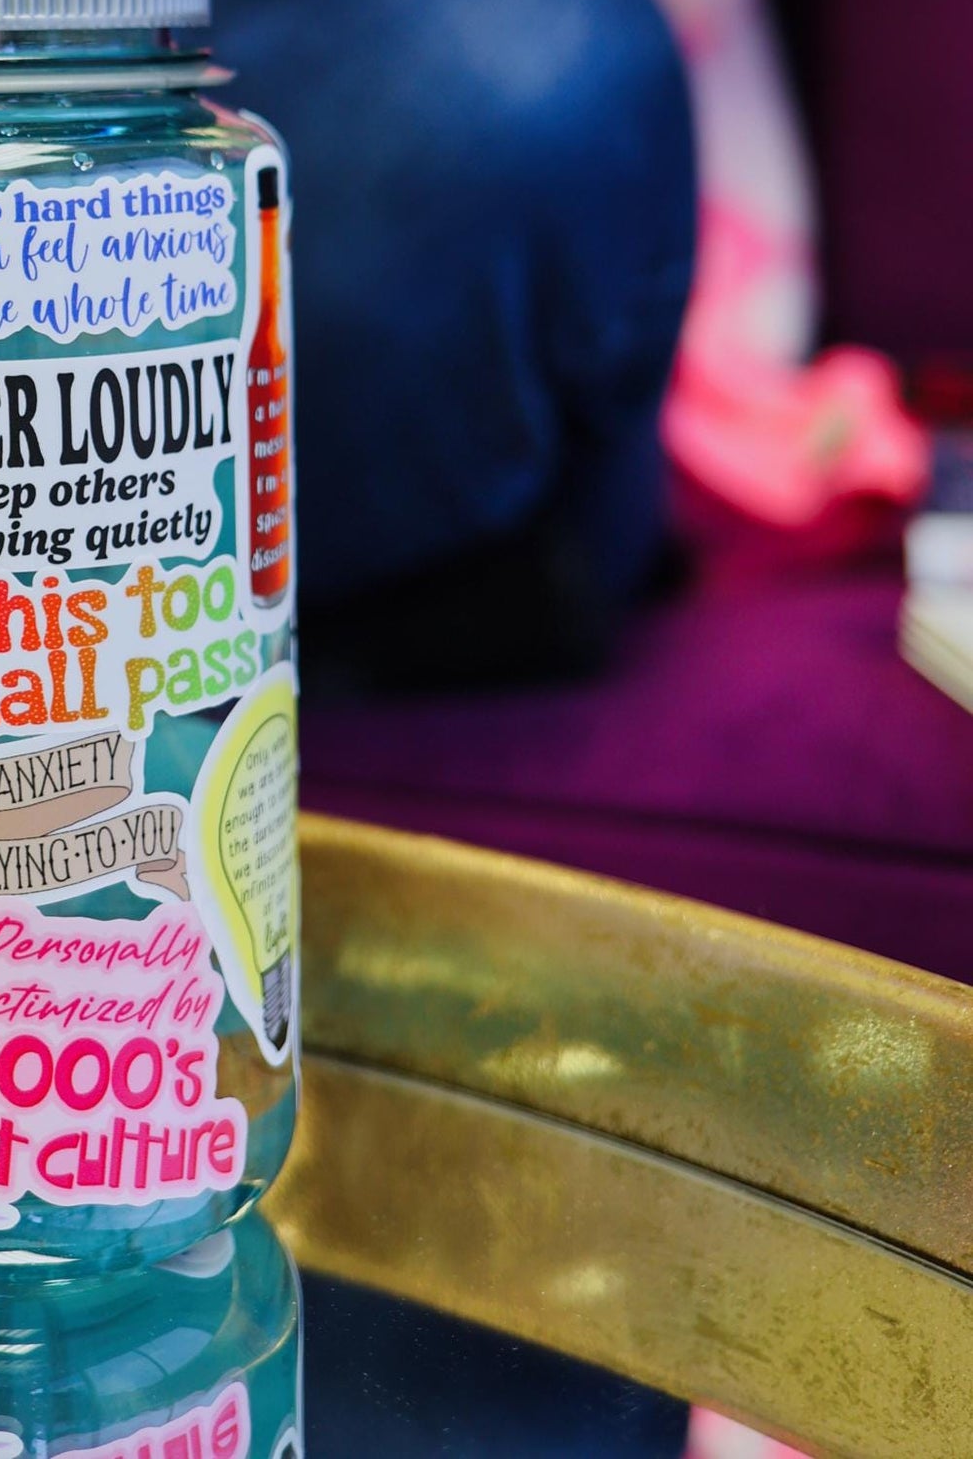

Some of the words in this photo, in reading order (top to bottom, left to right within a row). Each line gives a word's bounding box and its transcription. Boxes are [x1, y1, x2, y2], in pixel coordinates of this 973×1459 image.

[13, 188, 111, 223] hard
[122, 182, 225, 218] things
[22, 222, 89, 281] feel
[101, 222, 228, 264] anxious
[33, 277, 154, 334] whole
[160, 272, 230, 321] time
[57, 352, 235, 466] LOUDLY
[49, 468, 176, 507] others
[86, 503, 212, 560] quietly
[125, 564, 235, 639] too
[124, 629, 257, 731] pass
[75, 826, 117, 874] TO
[123, 810, 176, 861] YOU
[173, 978, 212, 1027] by
[36, 1116, 235, 1190] culture
